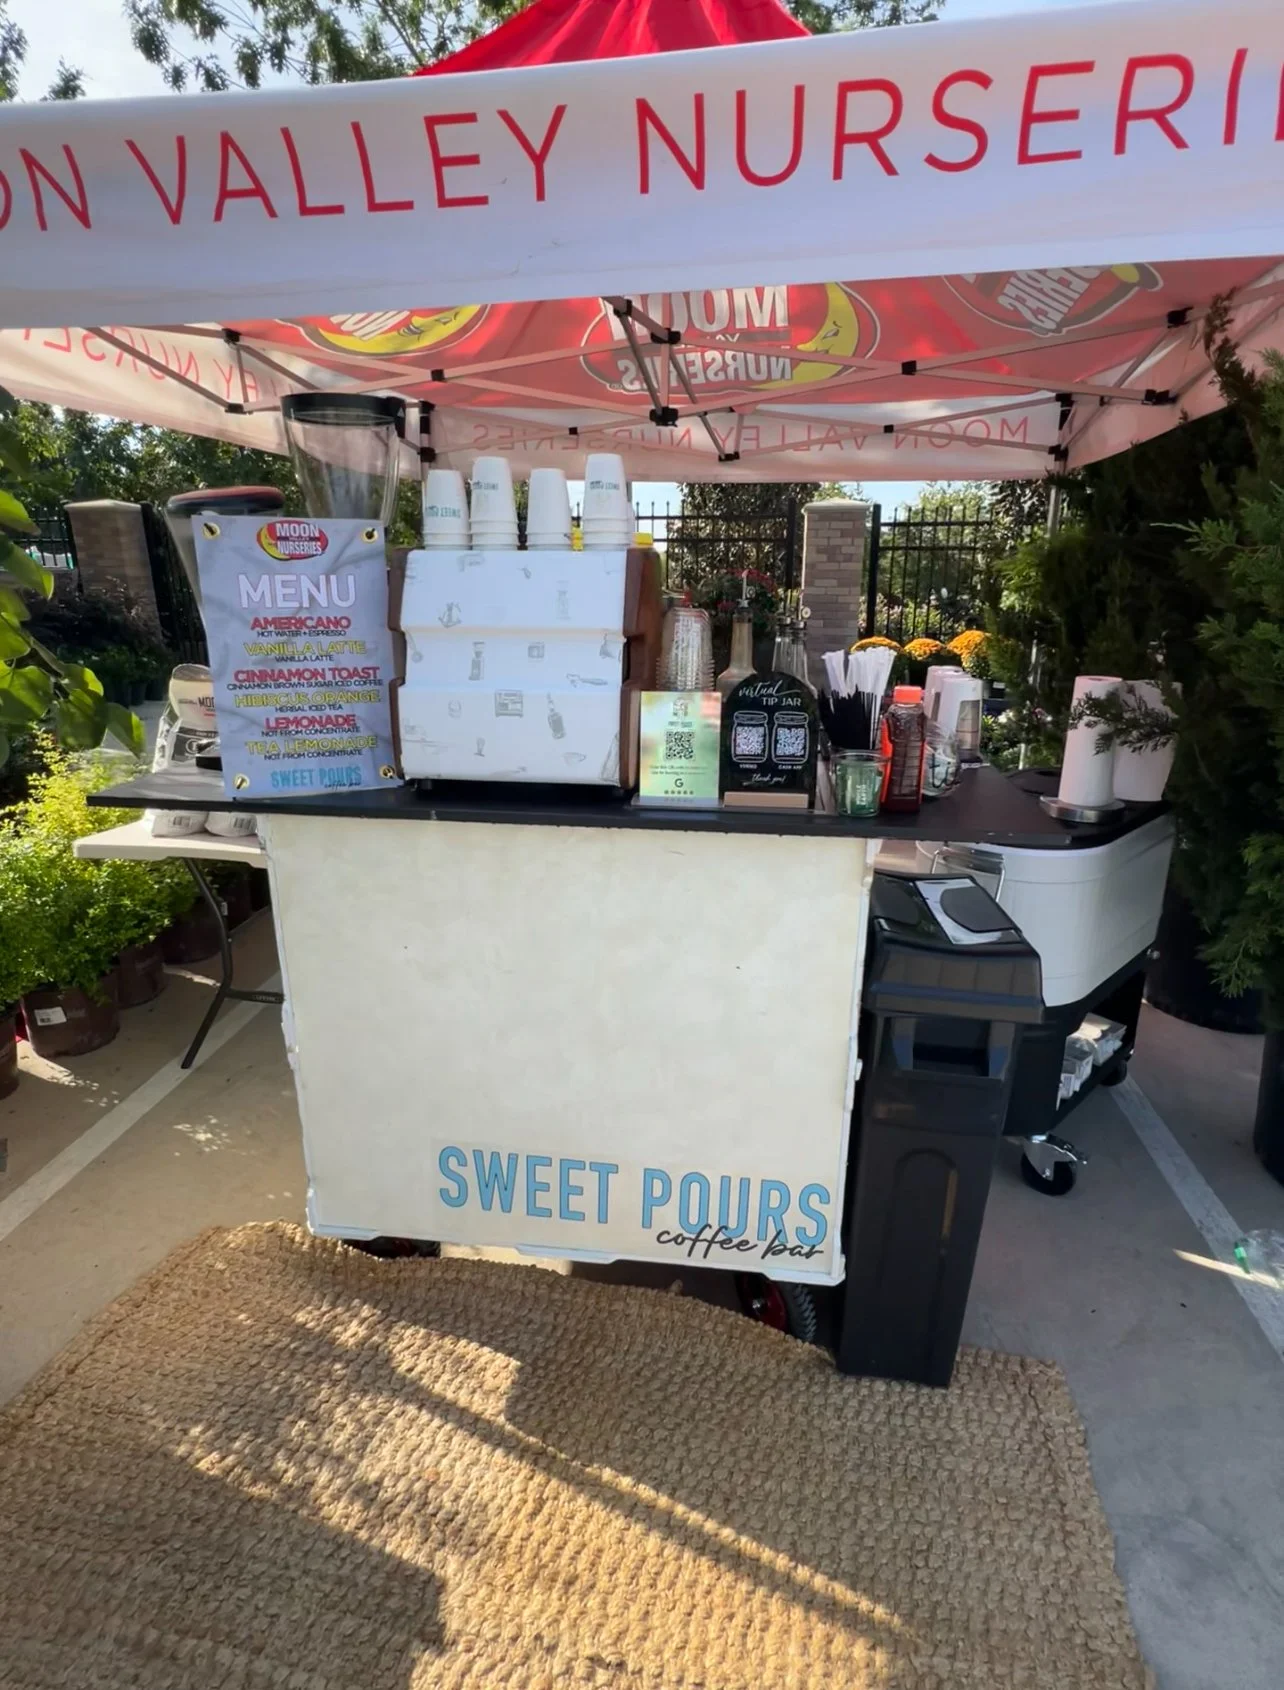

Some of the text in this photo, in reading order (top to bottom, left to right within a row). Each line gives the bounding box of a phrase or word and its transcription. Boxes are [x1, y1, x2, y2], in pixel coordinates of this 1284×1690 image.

[125, 104, 568, 225] VALLEY
[635, 48, 1284, 195] NURSERI
[275, 523, 320, 537] MOON
[276, 540, 322, 554] NURSERIES
[238, 574, 356, 608] MENU
[251, 616, 351, 630] AMERICANO
[257, 630, 273, 638] HOT
[275, 630, 301, 638] WATER
[243, 640, 366, 656] VANILLA LATTE
[234, 666, 380, 683] CINNAMON TOAST
[227, 682, 273, 691] CINNAMON
[274, 681, 305, 689] BROWN
[306, 680, 333, 688] SUGAR
[353, 679, 384, 687] COFFEE
[738, 680, 801, 698] virtual
[234, 689, 381, 708] HIBISCUS ORANGE
[762, 697, 802, 706] TIP JAR
[275, 703, 343, 713] HERBAL ICED TEA
[265, 714, 357, 730] LEMONADE
[261, 726, 361, 738] NOT FROM CONCENTRATE
[245, 735, 378, 755] TEA LEMONADE
[264, 750, 363, 761] NOT FROM CONCENTRATE
[270, 766, 362, 789] SWEET POURS
[438, 1145, 831, 1247] SWEET POURS
[655, 1223, 826, 1261] coffee bar
